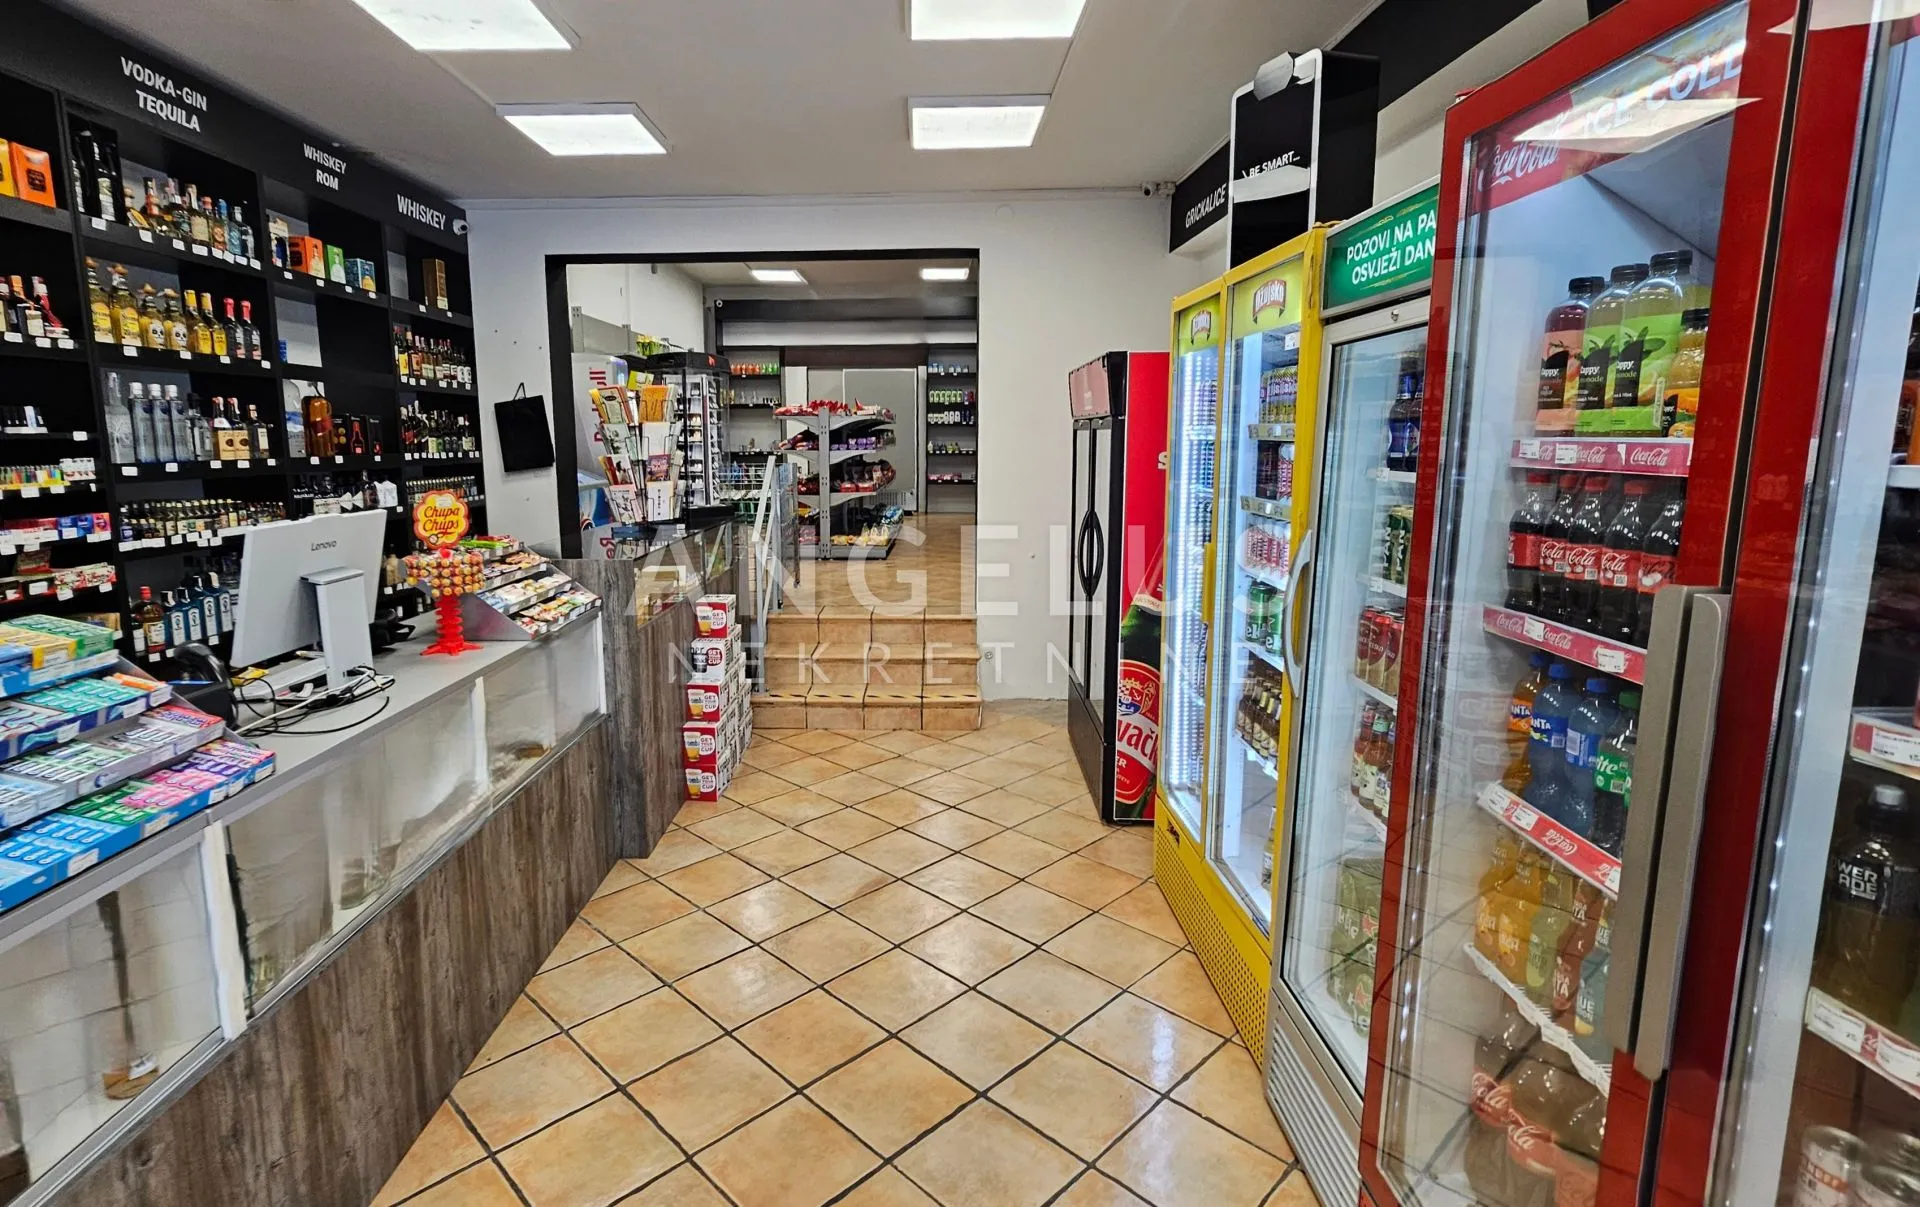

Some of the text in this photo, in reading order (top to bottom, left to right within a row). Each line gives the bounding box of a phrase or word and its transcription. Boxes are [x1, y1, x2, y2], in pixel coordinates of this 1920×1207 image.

[121, 56, 207, 112] VODKA-GIN
[136, 89, 201, 133] TEQUILA
[303, 143, 347, 174] WHISKEY
[1249, 165, 1261, 178] BE
[316, 169, 339, 190] ROM
[397, 194, 446, 230] WHISKEY
[1185, 183, 1227, 228] GRICKALICE
[1346, 209, 1437, 265] POZOVI NA PA
[1352, 235, 1436, 285] OSVJEŽI DAN
[423, 505, 459, 518] Chupa
[423, 518, 459, 533] Chups
[311, 540, 337, 552] Lenovo
